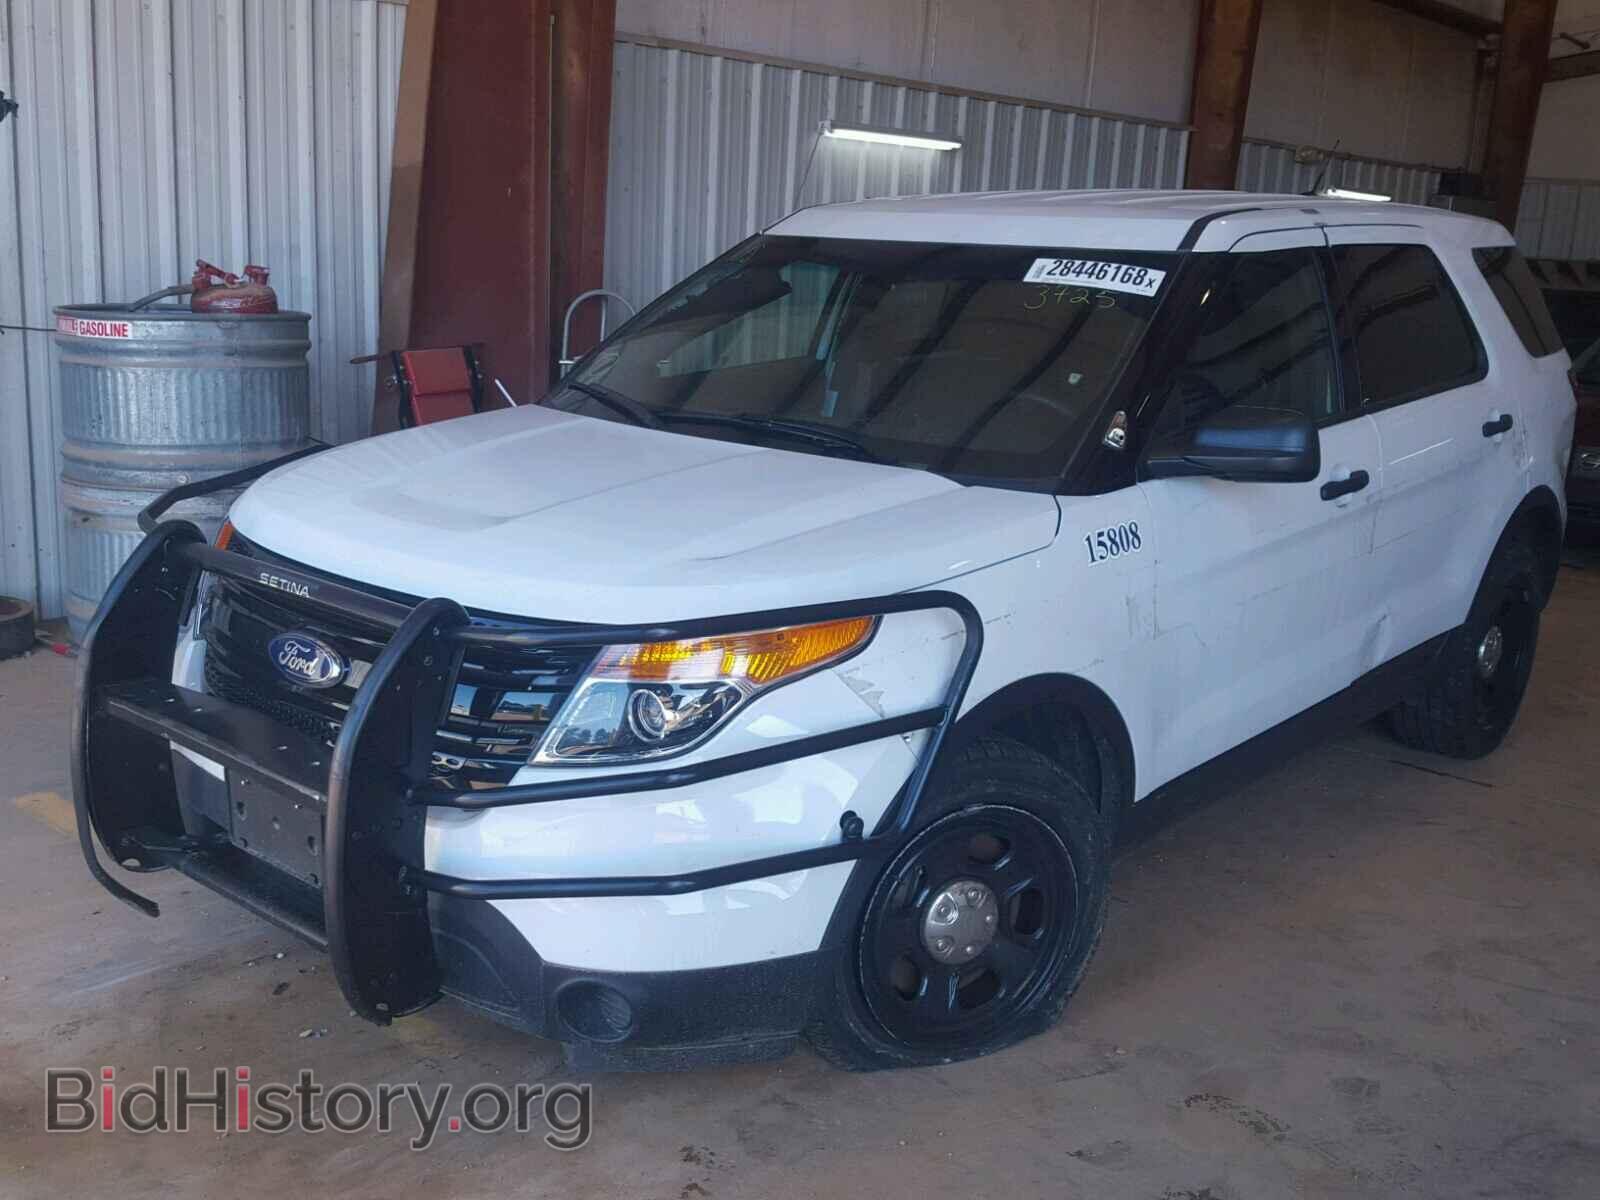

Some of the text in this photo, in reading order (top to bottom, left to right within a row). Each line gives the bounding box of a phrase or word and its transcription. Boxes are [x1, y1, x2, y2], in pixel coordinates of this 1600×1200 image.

[79, 321, 129, 338] GASOLINE
[1084, 521, 1142, 564] 15808
[258, 572, 311, 599] SETINA
[278, 640, 319, 676] Ford
